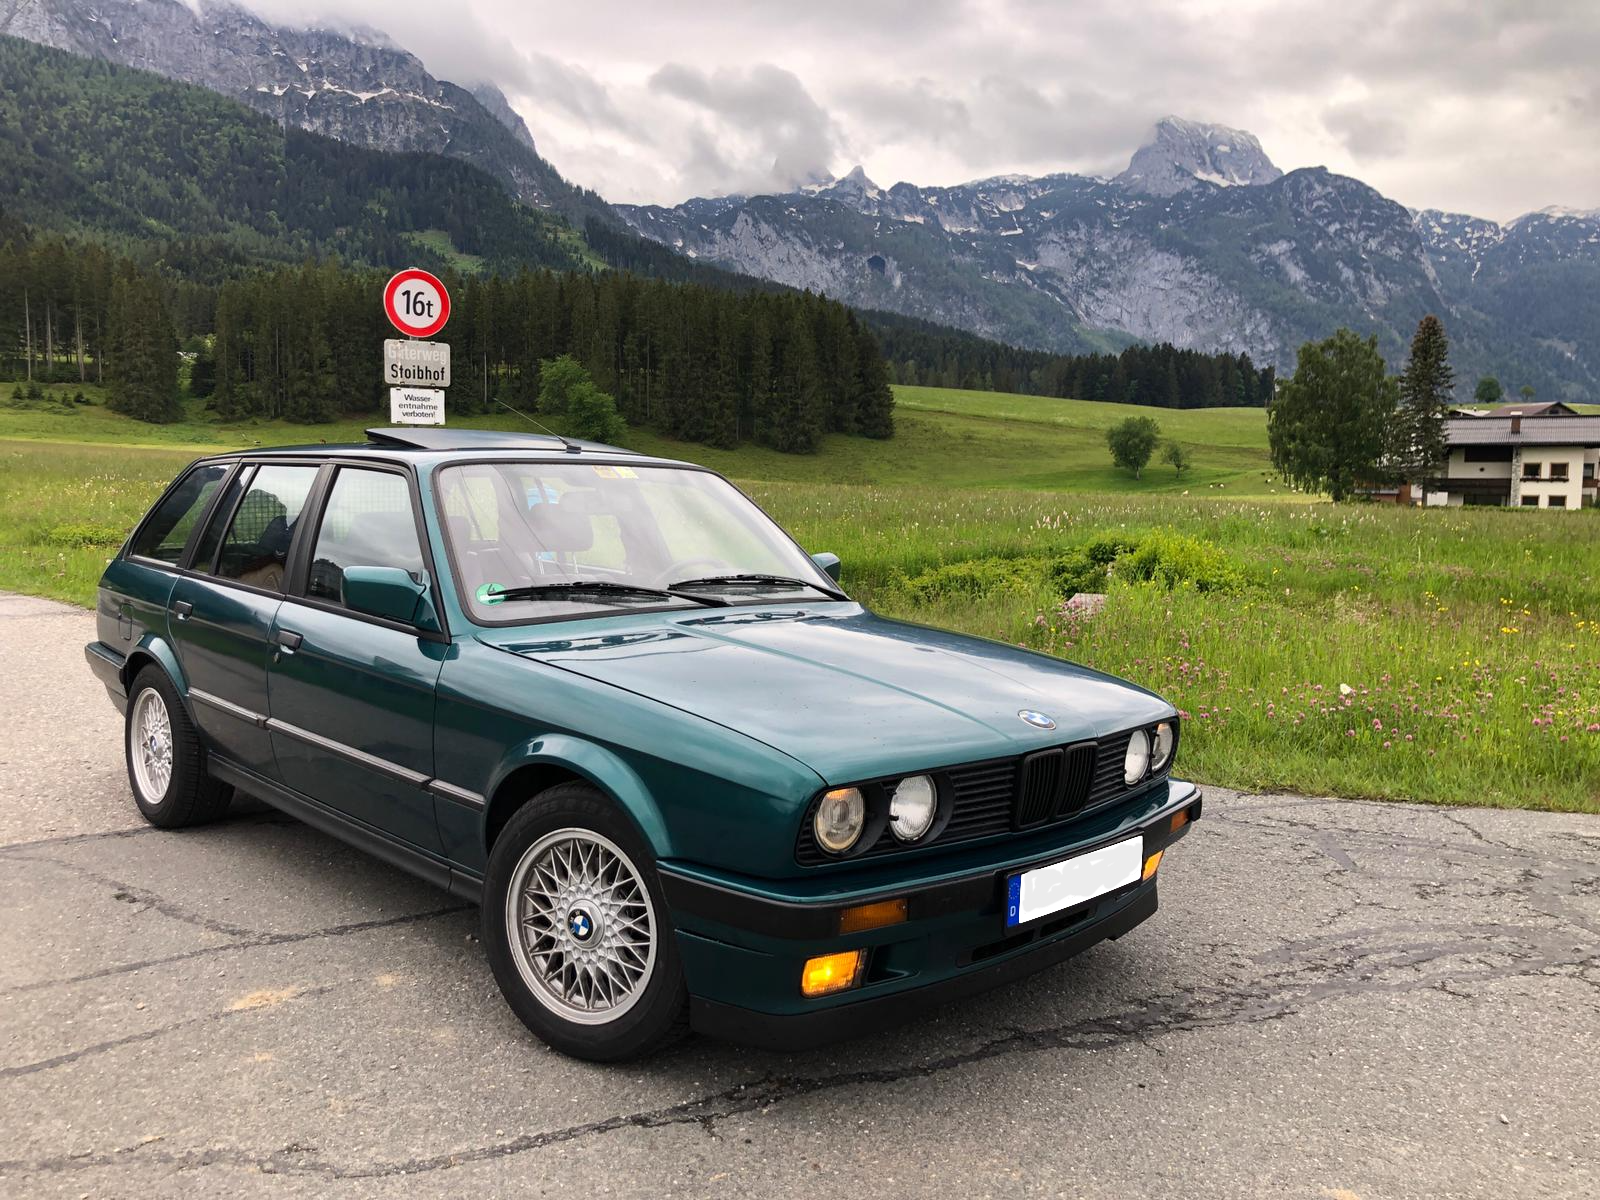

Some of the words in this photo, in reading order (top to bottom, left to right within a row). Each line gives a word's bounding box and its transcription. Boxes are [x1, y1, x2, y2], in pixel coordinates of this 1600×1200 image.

[401, 289, 434, 318] 16t
[391, 363, 445, 381] Stoibhof
[404, 393, 433, 402] Wasser-
[398, 403, 438, 411] entnahme
[402, 410, 436, 419] verboten!
[1009, 905, 1016, 917] D
